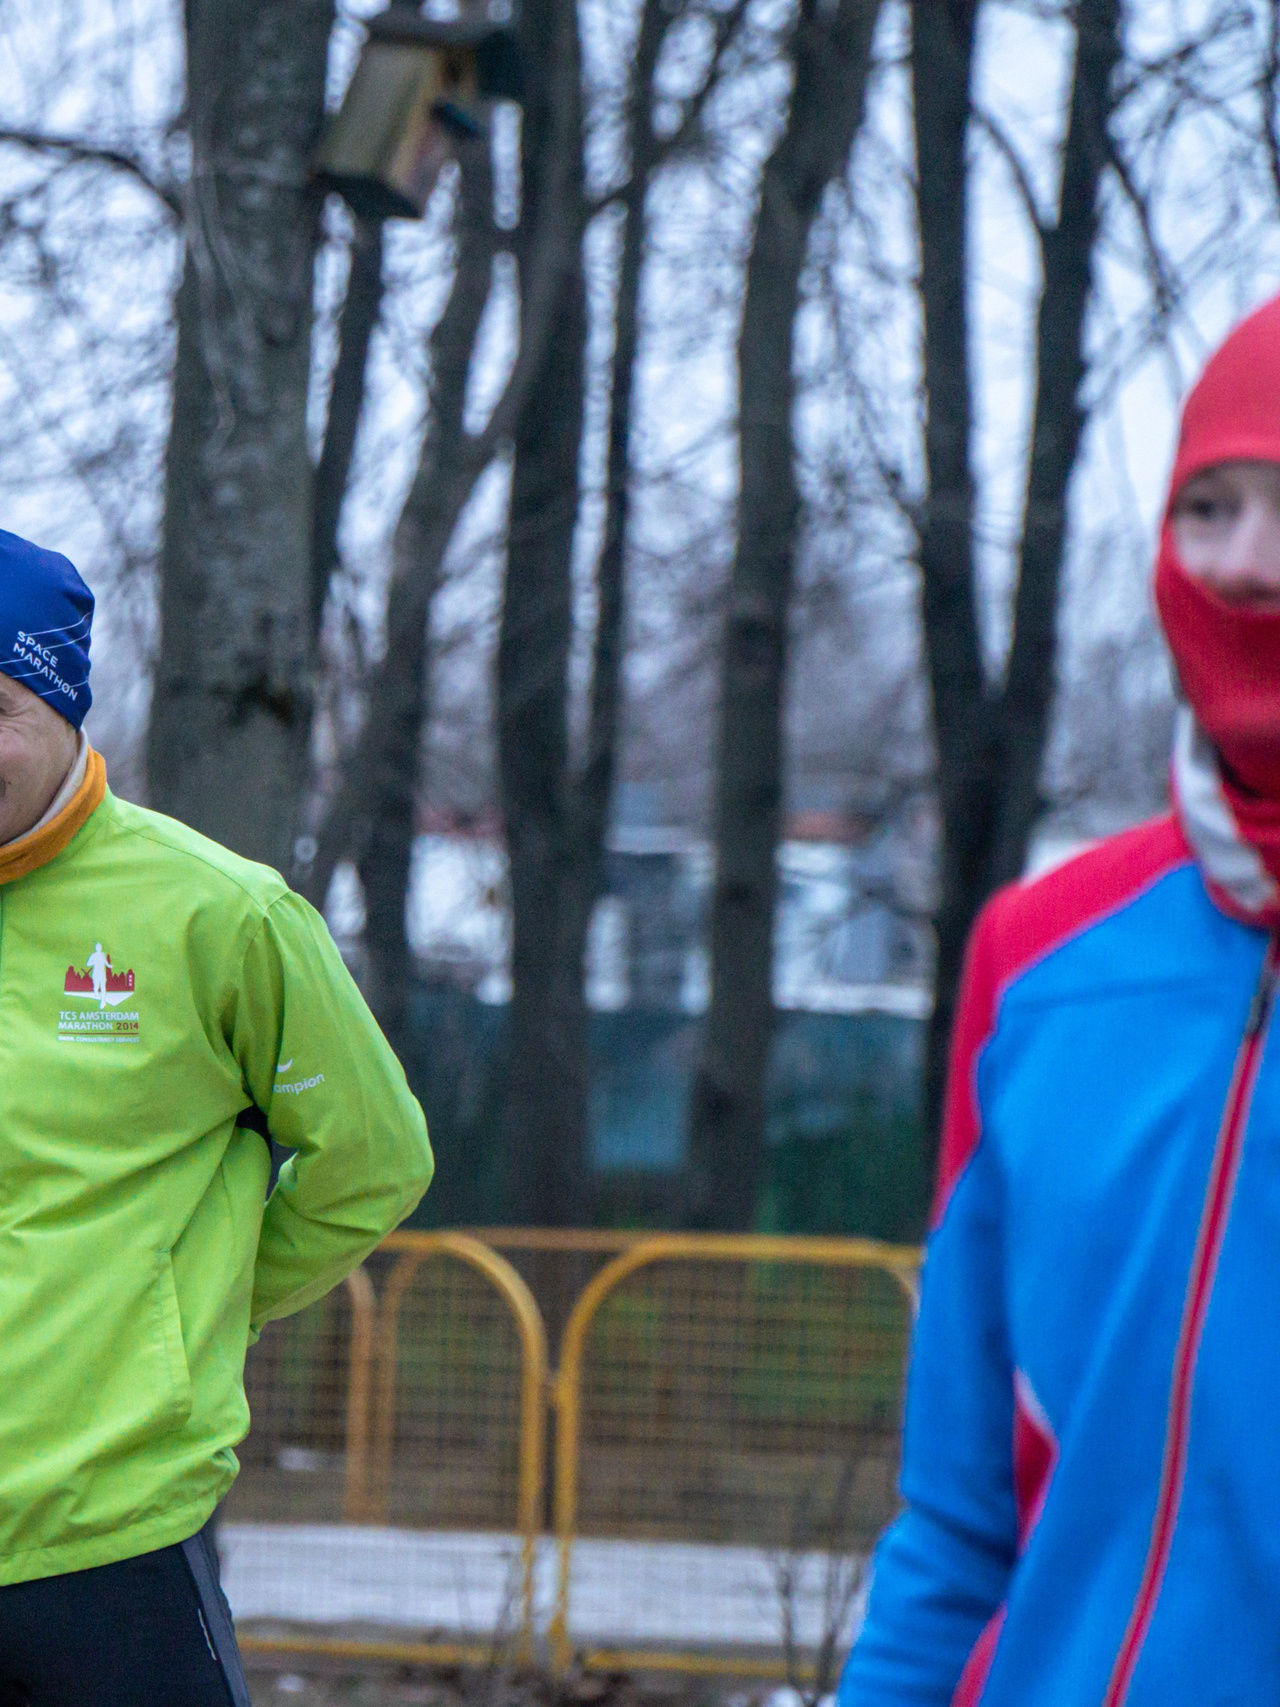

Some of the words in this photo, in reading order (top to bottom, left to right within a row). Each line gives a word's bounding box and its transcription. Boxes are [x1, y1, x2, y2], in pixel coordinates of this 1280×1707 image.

[17, 631, 59, 667] SPACE
[13, 642, 78, 701] MARATHON
[58, 1022, 113, 1030] MARATHON
[116, 1022, 139, 1031] 2014
[59, 1011, 76, 1020] TCS
[79, 1011, 139, 1020] AMSTERDAM
